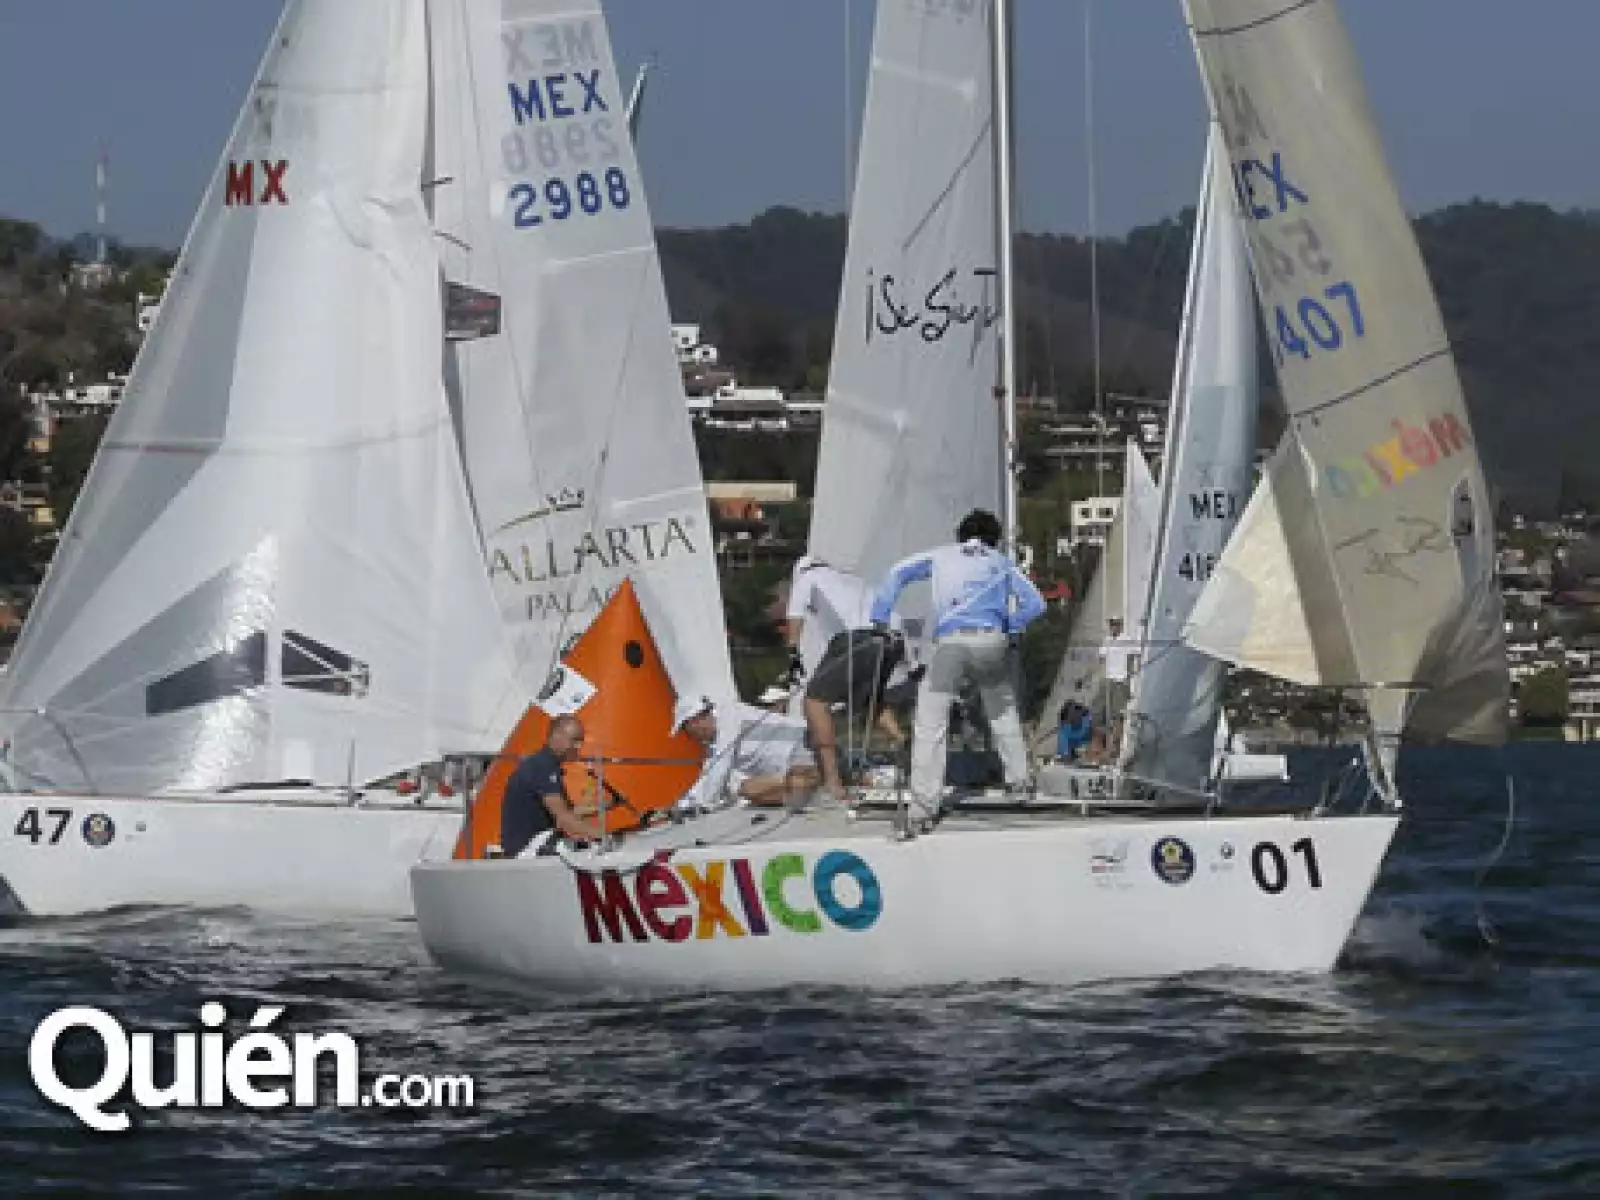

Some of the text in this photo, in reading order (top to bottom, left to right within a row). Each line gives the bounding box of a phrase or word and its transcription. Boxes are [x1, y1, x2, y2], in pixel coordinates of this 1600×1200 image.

[507, 68, 609, 126] MEX
[224, 159, 290, 206] MX
[507, 166, 631, 229] 2988
[1230, 152, 1310, 220] EX
[1275, 281, 1366, 360] 407
[486, 517, 697, 584] ALLARTA
[13, 806, 74, 846] 47
[1250, 836, 1323, 895] 01
